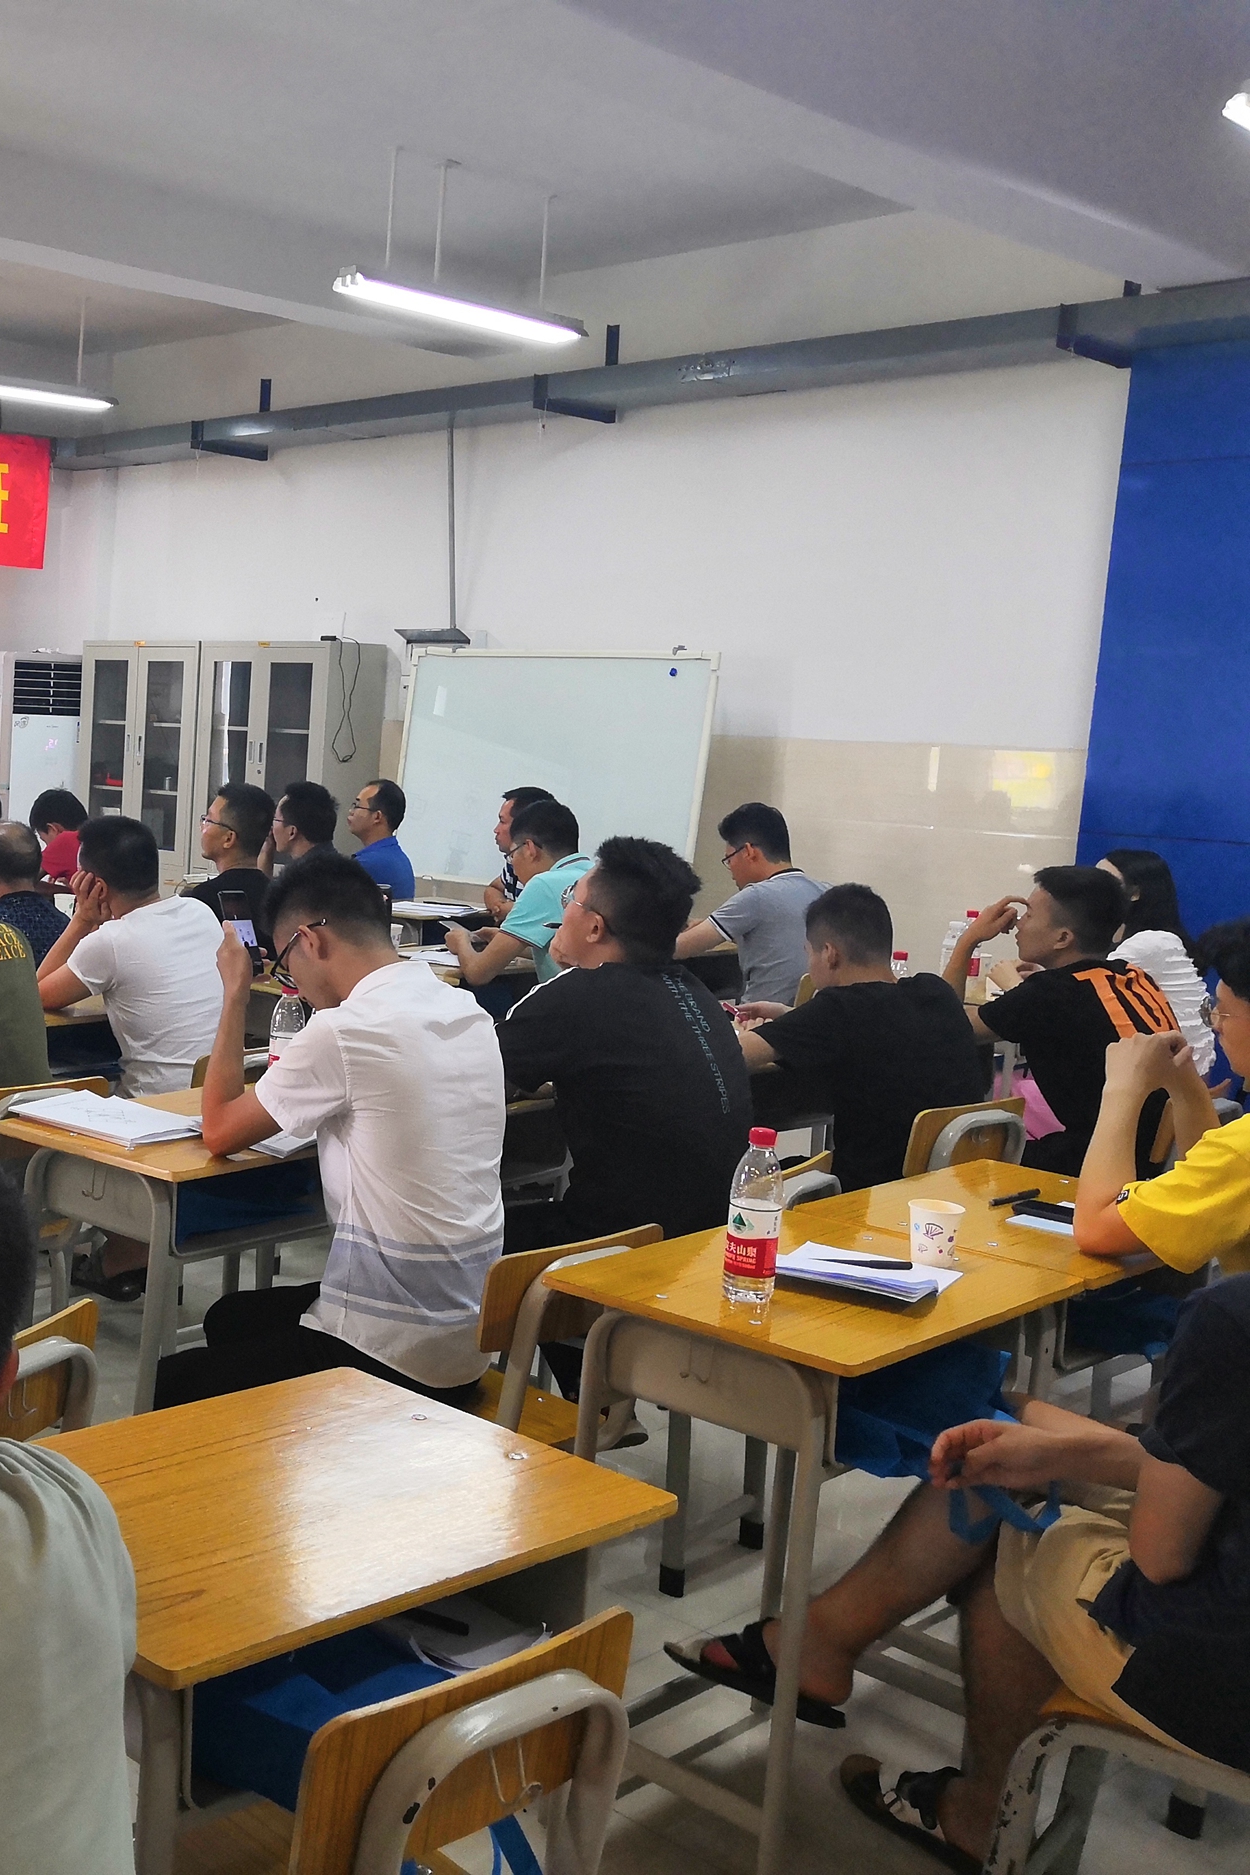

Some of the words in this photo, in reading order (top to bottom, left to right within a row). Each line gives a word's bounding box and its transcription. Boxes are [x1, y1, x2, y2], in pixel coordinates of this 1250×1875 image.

[684, 993, 712, 1033] BRAND
[678, 1001, 695, 1022] THE
[692, 1024, 715, 1061] THREE
[710, 1062, 731, 1115] STRIPES
